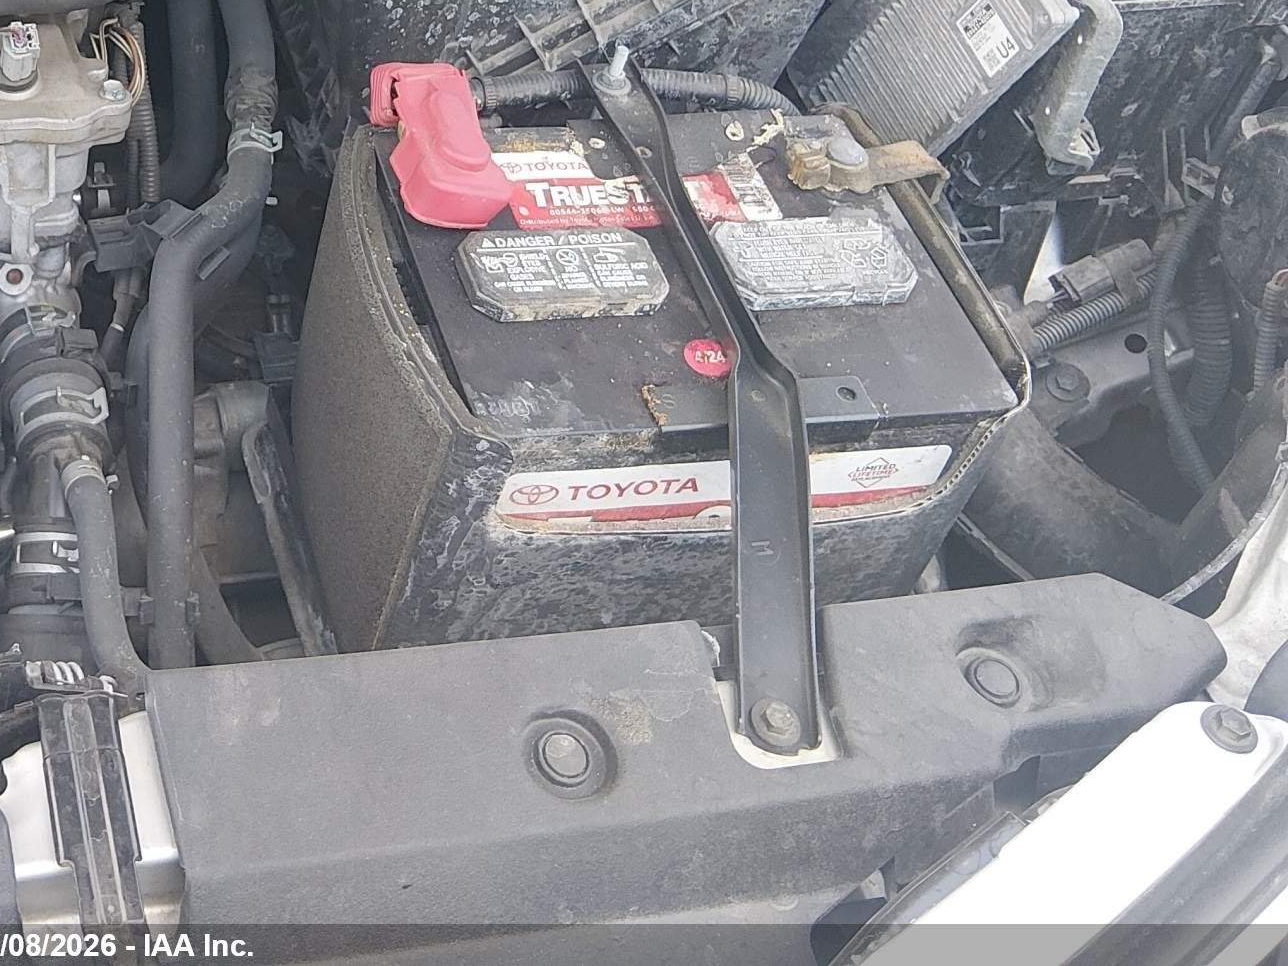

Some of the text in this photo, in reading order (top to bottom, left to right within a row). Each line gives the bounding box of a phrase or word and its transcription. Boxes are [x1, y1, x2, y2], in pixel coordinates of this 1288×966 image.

[523, 161, 589, 172] TOYOTA
[495, 234, 554, 248] DANGER
[569, 232, 622, 245] POISON
[568, 477, 699, 501] TOYOTA
